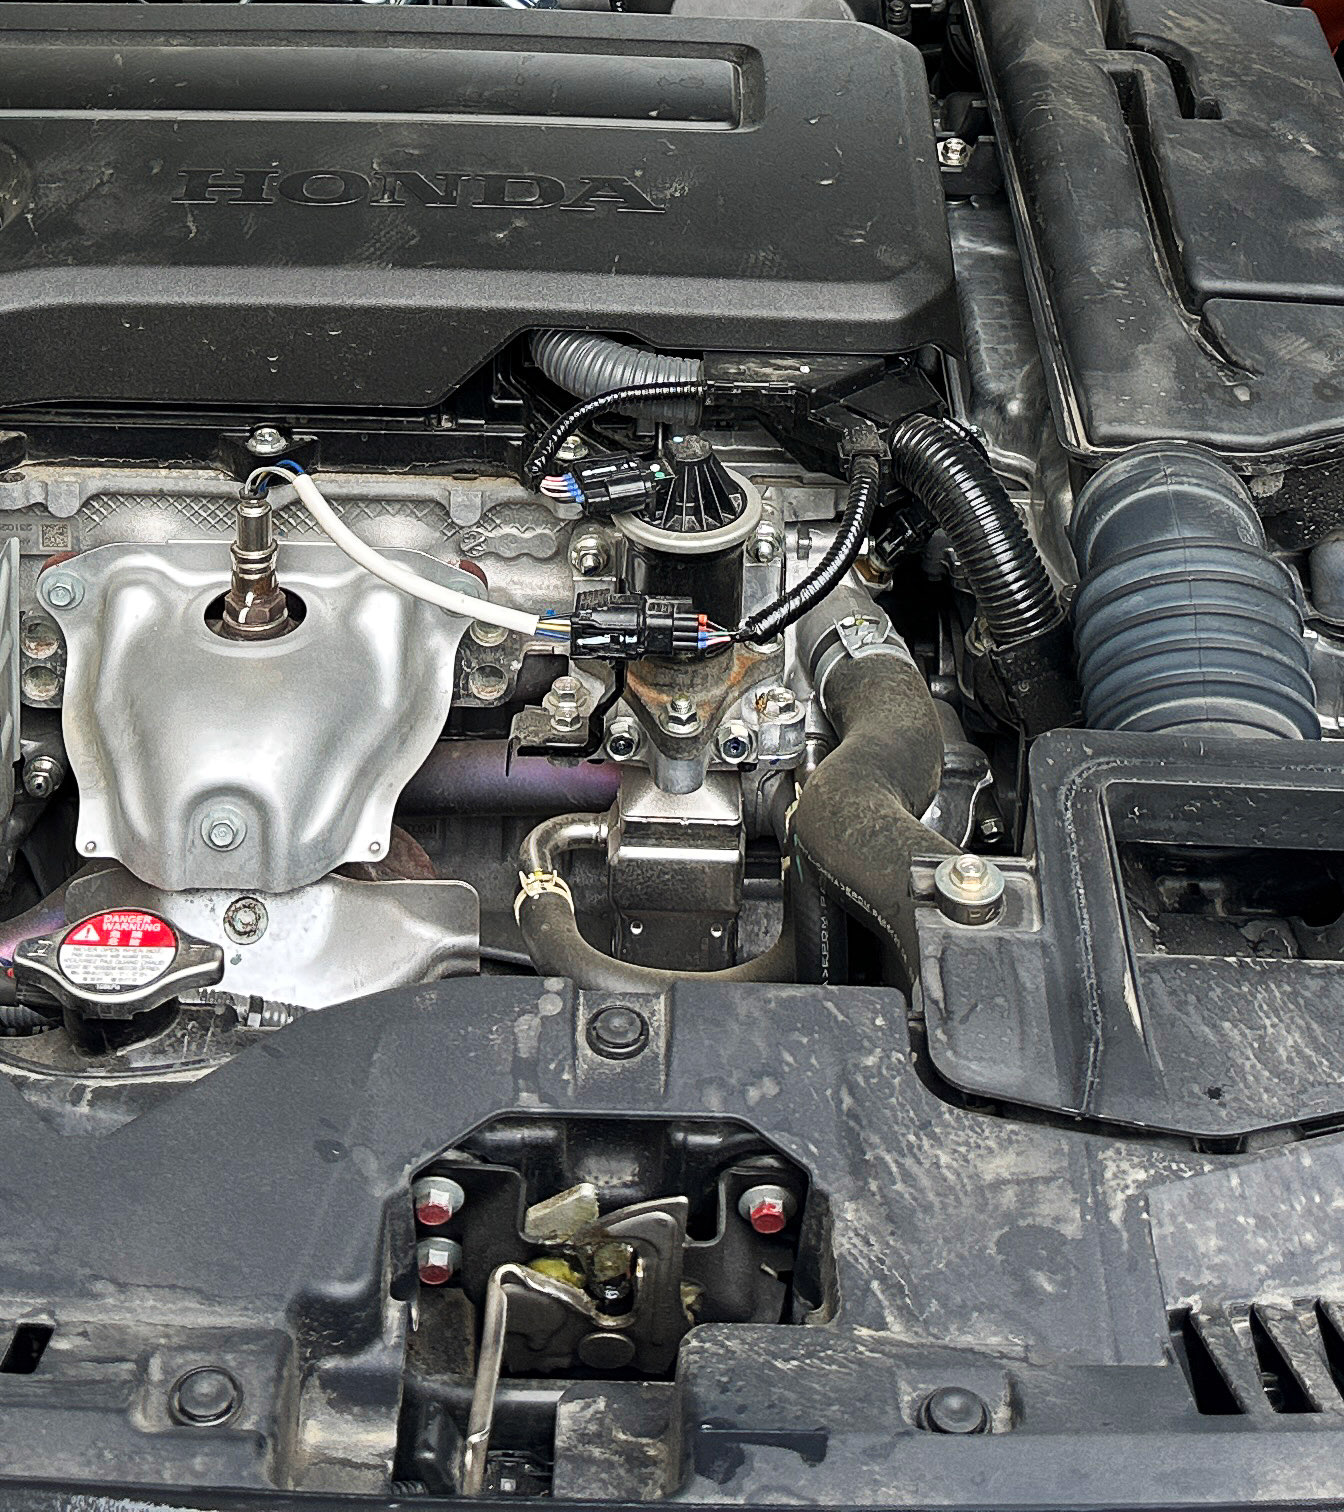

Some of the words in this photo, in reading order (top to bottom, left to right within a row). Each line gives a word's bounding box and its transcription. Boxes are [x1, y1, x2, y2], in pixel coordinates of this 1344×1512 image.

[170, 168, 667, 214] HONDA
[103, 914, 153, 924] DANGER
[102, 922, 161, 932] WARNUNG
